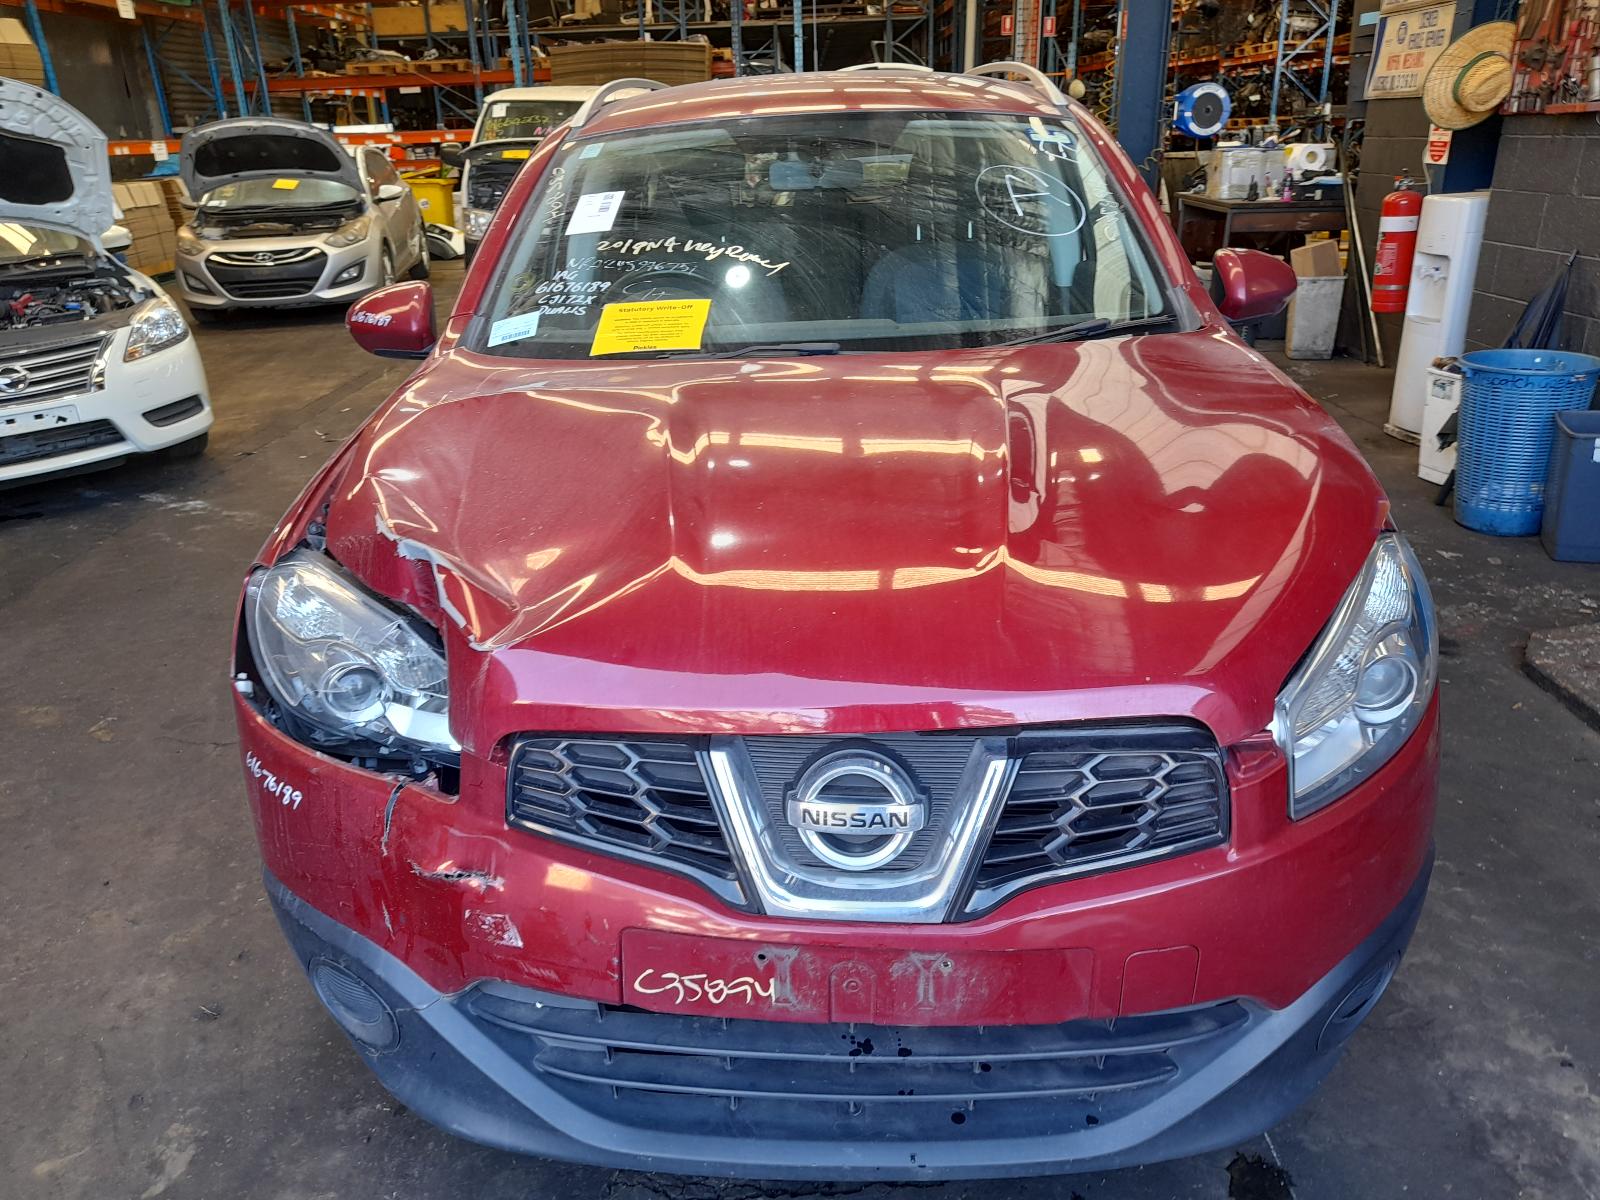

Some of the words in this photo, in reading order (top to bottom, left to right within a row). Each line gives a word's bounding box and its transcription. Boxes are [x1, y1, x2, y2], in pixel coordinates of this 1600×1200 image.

[552, 270, 579, 282] IAG
[535, 280, 612, 294] 61676189
[801, 808, 908, 829] NISSAN
[633, 968, 777, 1005] C35894
